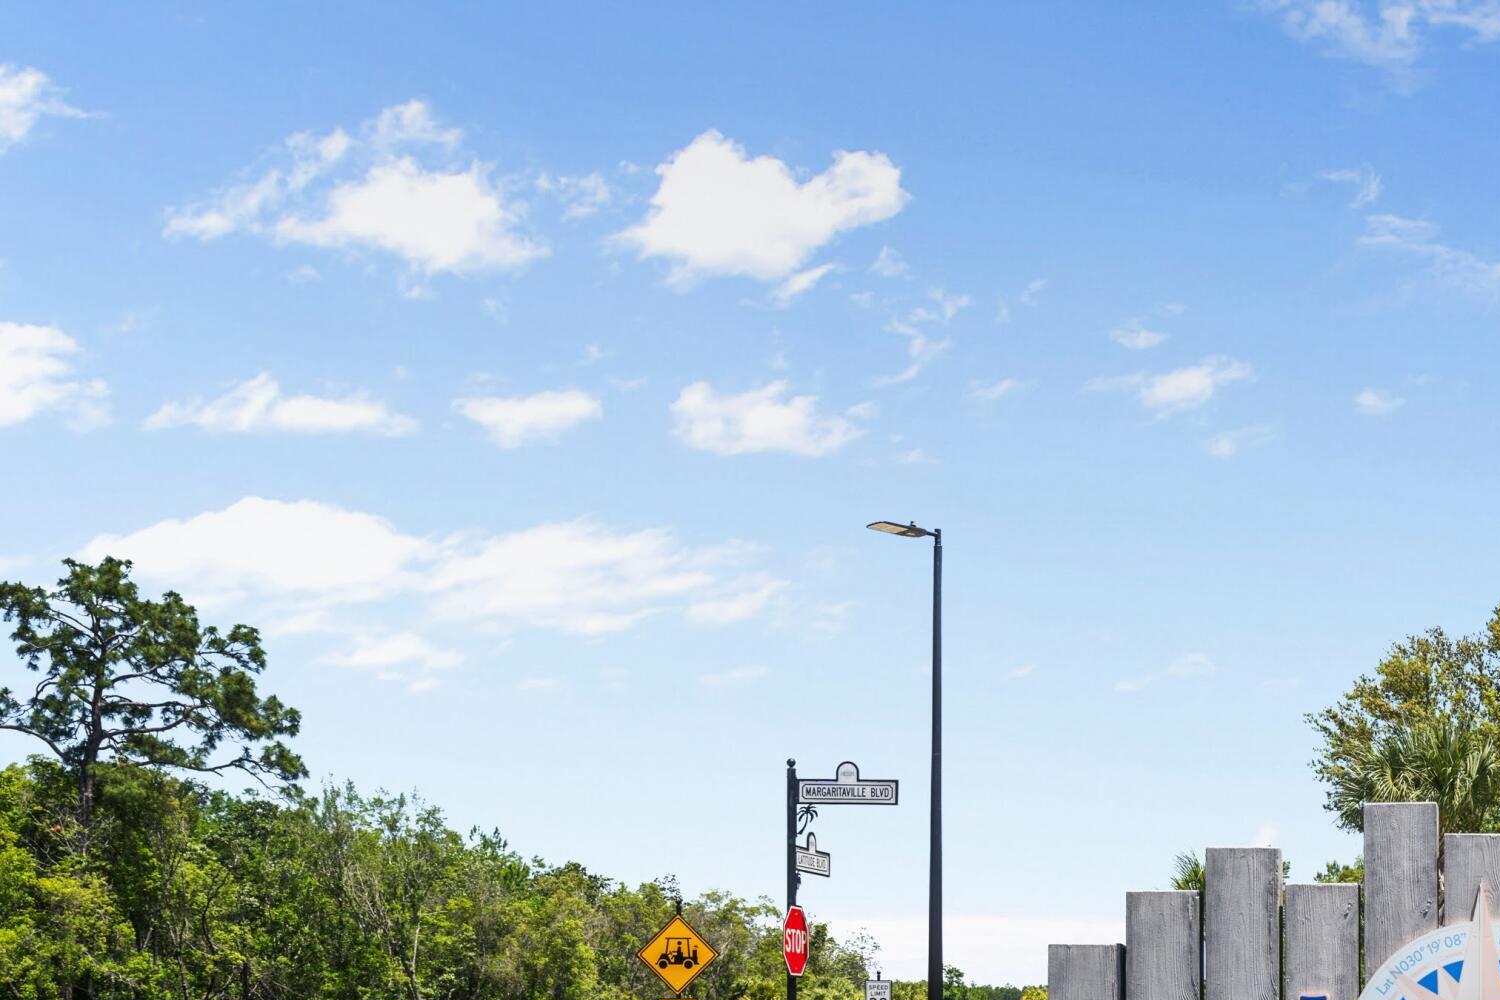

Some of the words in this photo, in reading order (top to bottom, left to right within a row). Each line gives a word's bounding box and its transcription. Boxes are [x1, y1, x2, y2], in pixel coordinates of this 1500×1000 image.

[805, 786, 866, 798] MARGARITAVILLE
[870, 787, 890, 798] BLVD
[785, 928, 807, 954] STOP
[1376, 979, 1394, 996] Lat
